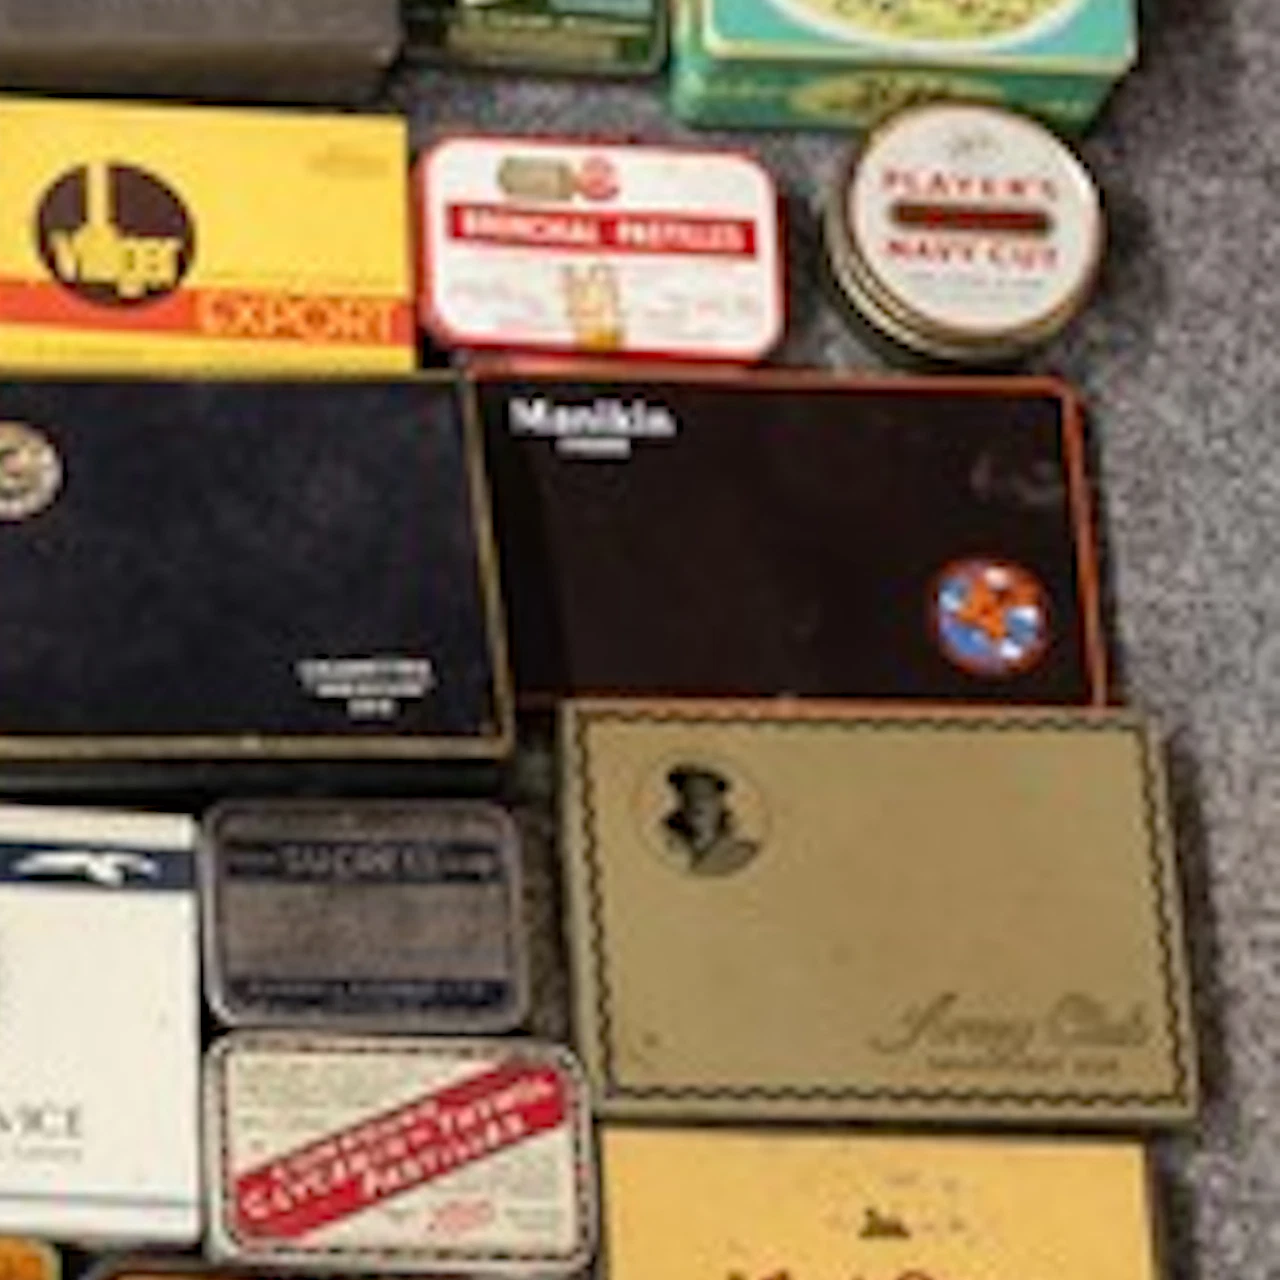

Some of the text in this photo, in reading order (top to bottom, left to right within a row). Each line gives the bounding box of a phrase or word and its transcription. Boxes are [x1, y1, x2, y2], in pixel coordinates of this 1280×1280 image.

[882, 170, 1062, 201] PLAYER'S
[886, 238, 980, 268] NAVY
[198, 294, 393, 343] EXPORT
[510, 399, 678, 438] Manikin
